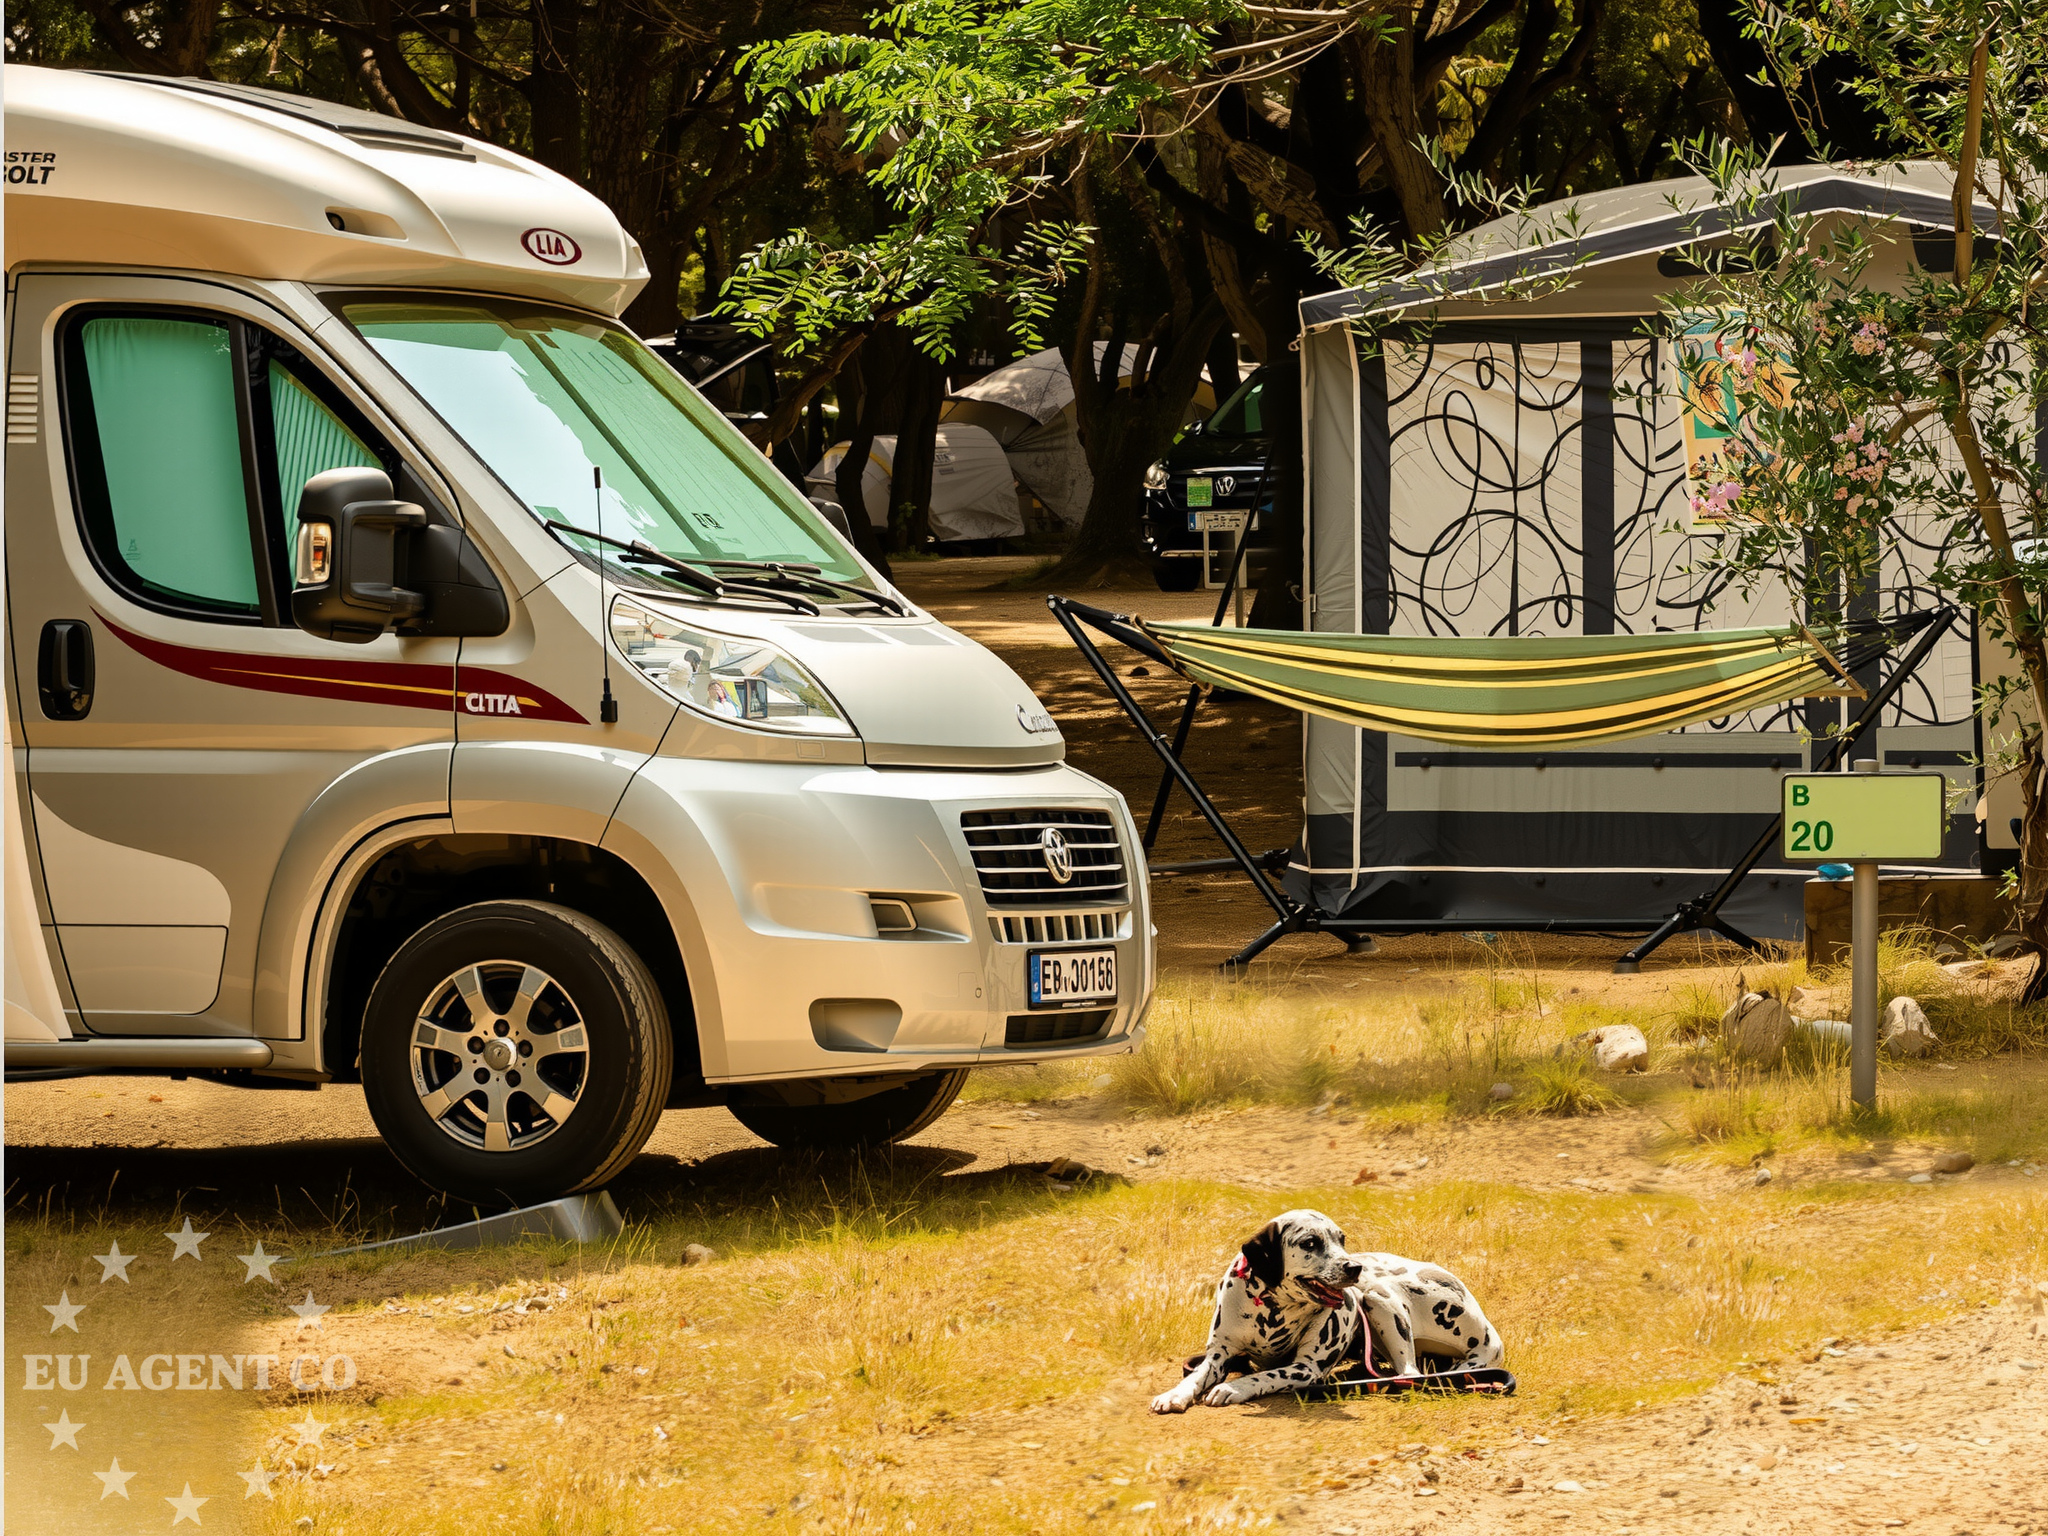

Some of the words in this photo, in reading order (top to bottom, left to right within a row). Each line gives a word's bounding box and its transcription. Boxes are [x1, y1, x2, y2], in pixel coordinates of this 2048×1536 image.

[535, 233, 568, 257] LIA
[1792, 784, 1810, 807] B
[1790, 820, 1834, 852] 20
